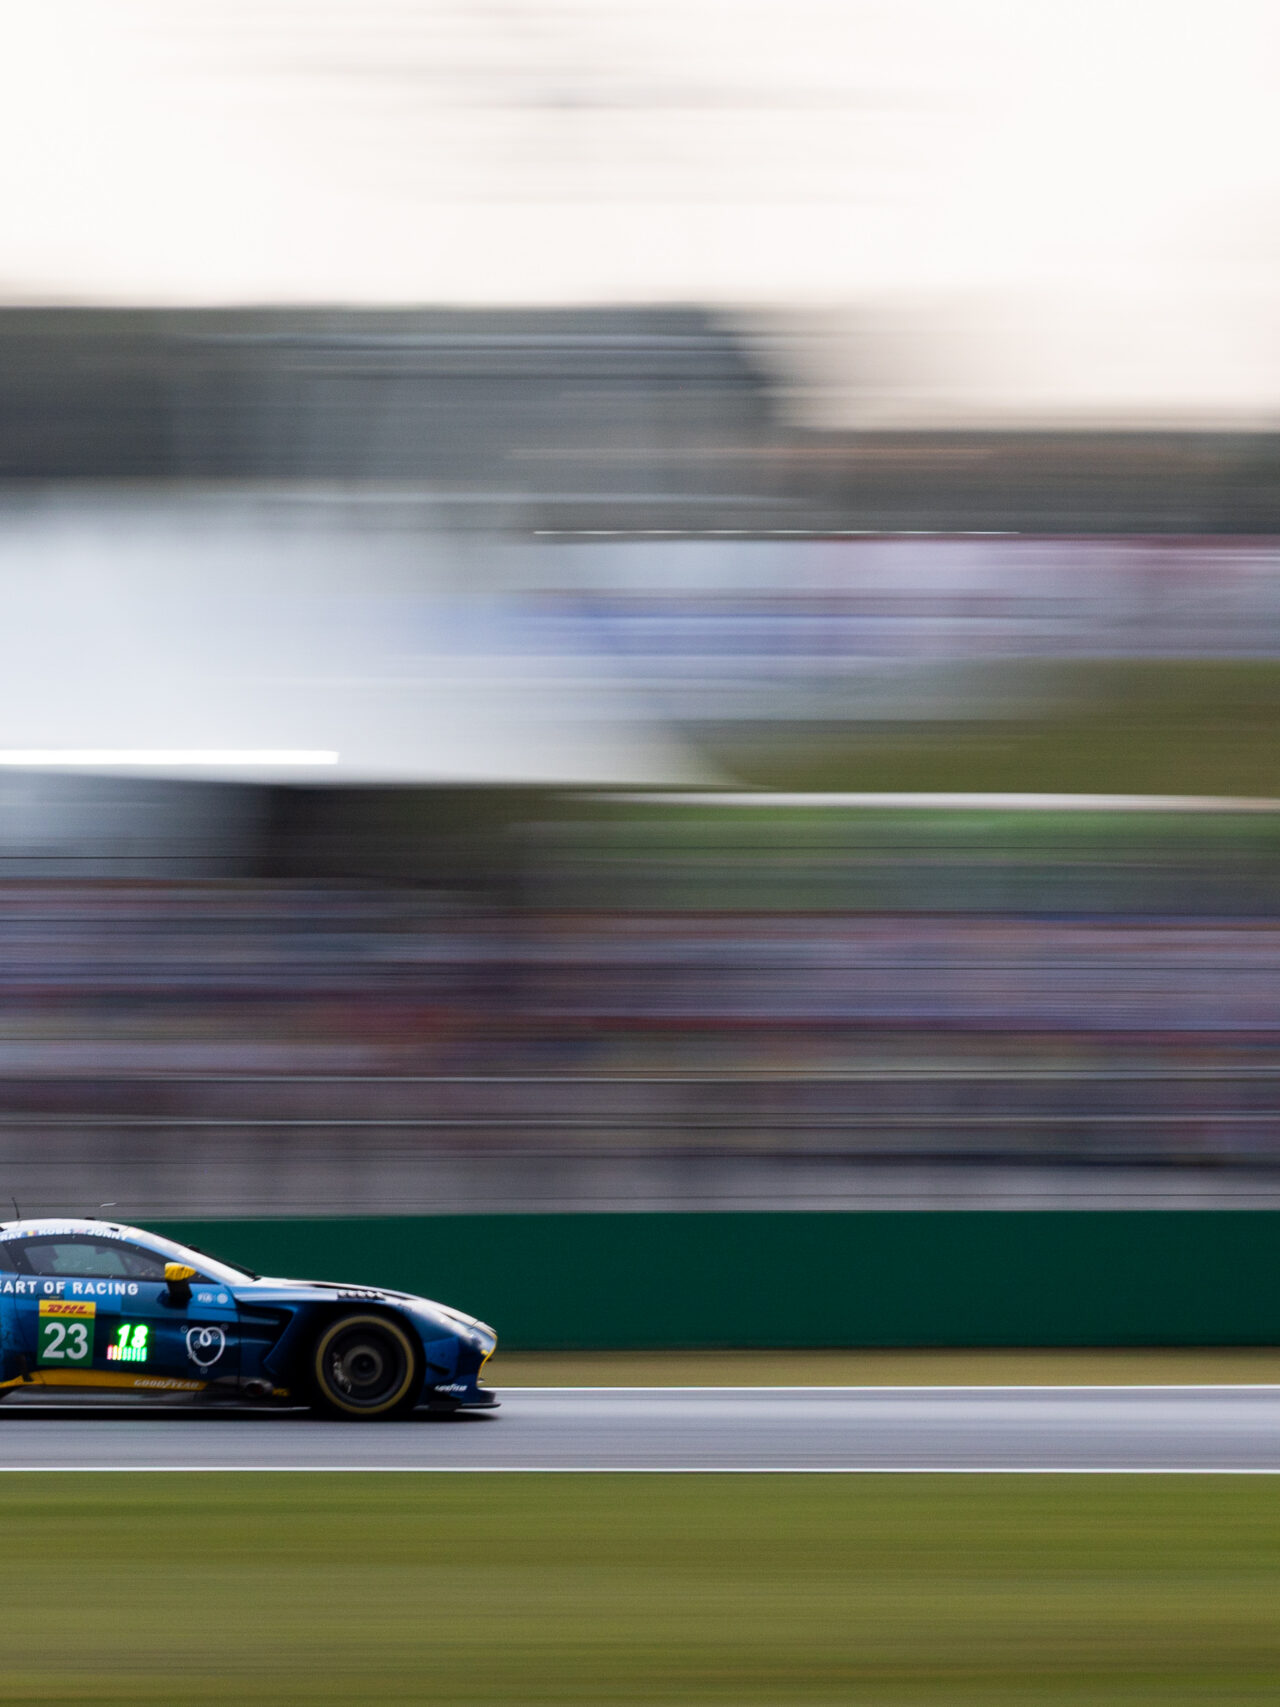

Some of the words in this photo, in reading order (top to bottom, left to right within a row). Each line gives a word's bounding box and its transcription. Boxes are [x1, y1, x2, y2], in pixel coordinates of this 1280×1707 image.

[43, 1281, 66, 1294] OF
[72, 1282, 139, 1296] RACING
[47, 1304, 88, 1315] DHL
[42, 1322, 89, 1360] 23
[117, 1323, 149, 1348] 18
[134, 1378, 199, 1390] GOODYEAR
